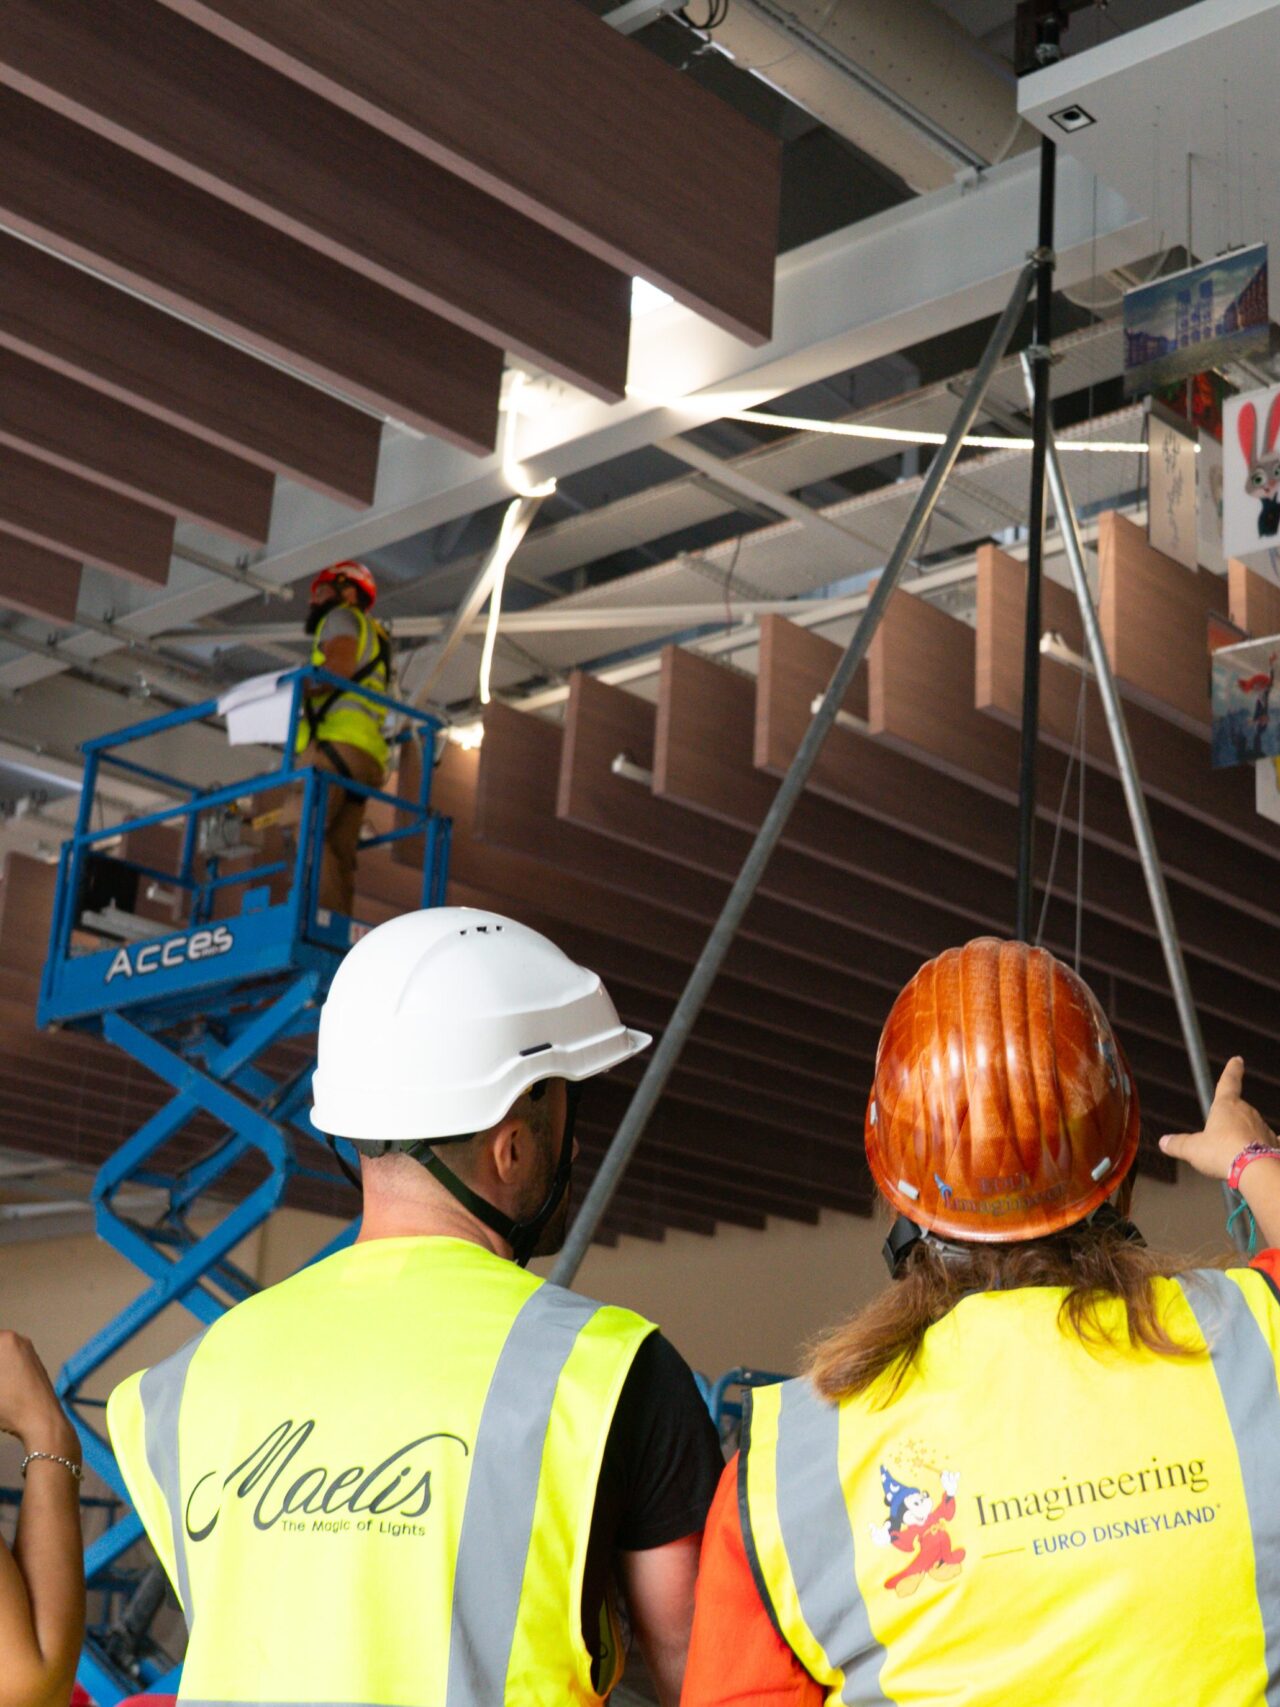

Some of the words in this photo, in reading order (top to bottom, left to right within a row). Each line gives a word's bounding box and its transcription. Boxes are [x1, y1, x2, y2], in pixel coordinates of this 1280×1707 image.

[974, 1457, 1210, 1526] Imagineering
[281, 1519, 306, 1532] The
[311, 1519, 351, 1534] Magic
[356, 1518, 374, 1532] of
[1032, 1530, 1087, 1556] EURO
[1092, 1505, 1217, 1543] DISNEYLAND
